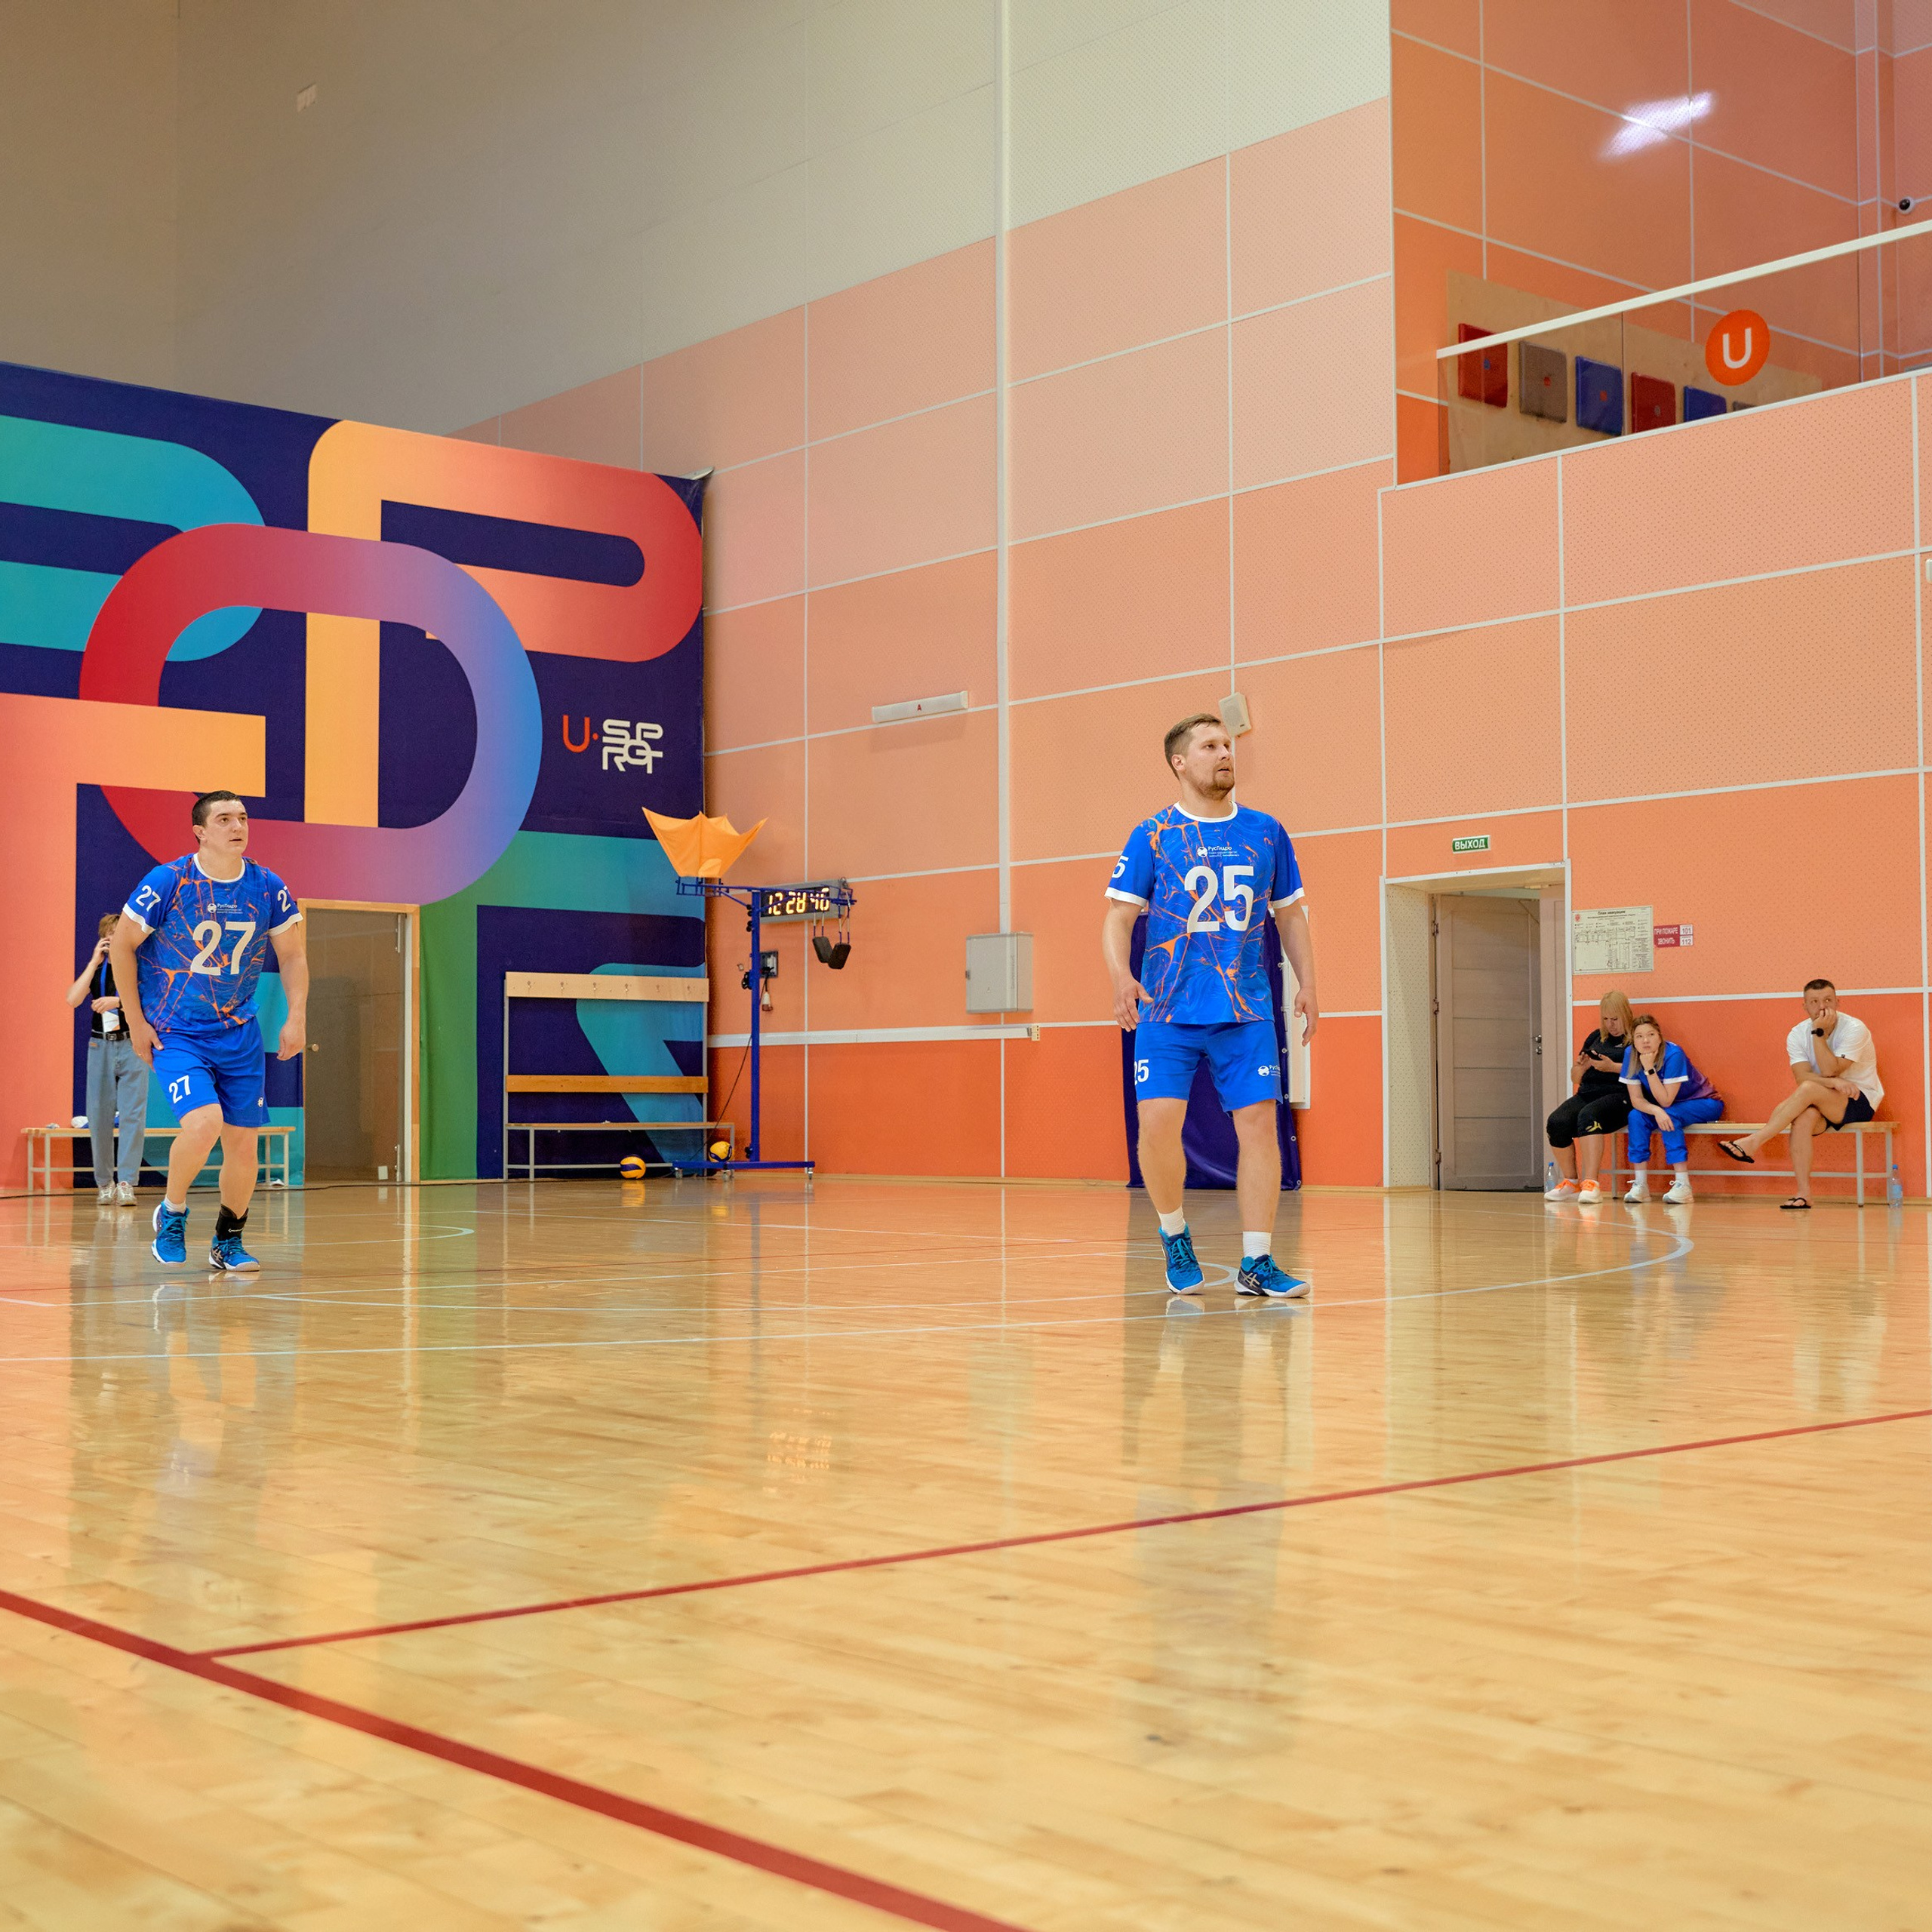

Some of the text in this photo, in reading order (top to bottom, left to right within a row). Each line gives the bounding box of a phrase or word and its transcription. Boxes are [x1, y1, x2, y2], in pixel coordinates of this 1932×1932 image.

[1722, 327, 1752, 369] U
[1454, 838, 1486, 851] ВЫХОД
[135, 884, 162, 912] 27
[1183, 865, 1254, 934] 25
[190, 920, 256, 976] 27
[168, 1075, 192, 1104] 27
